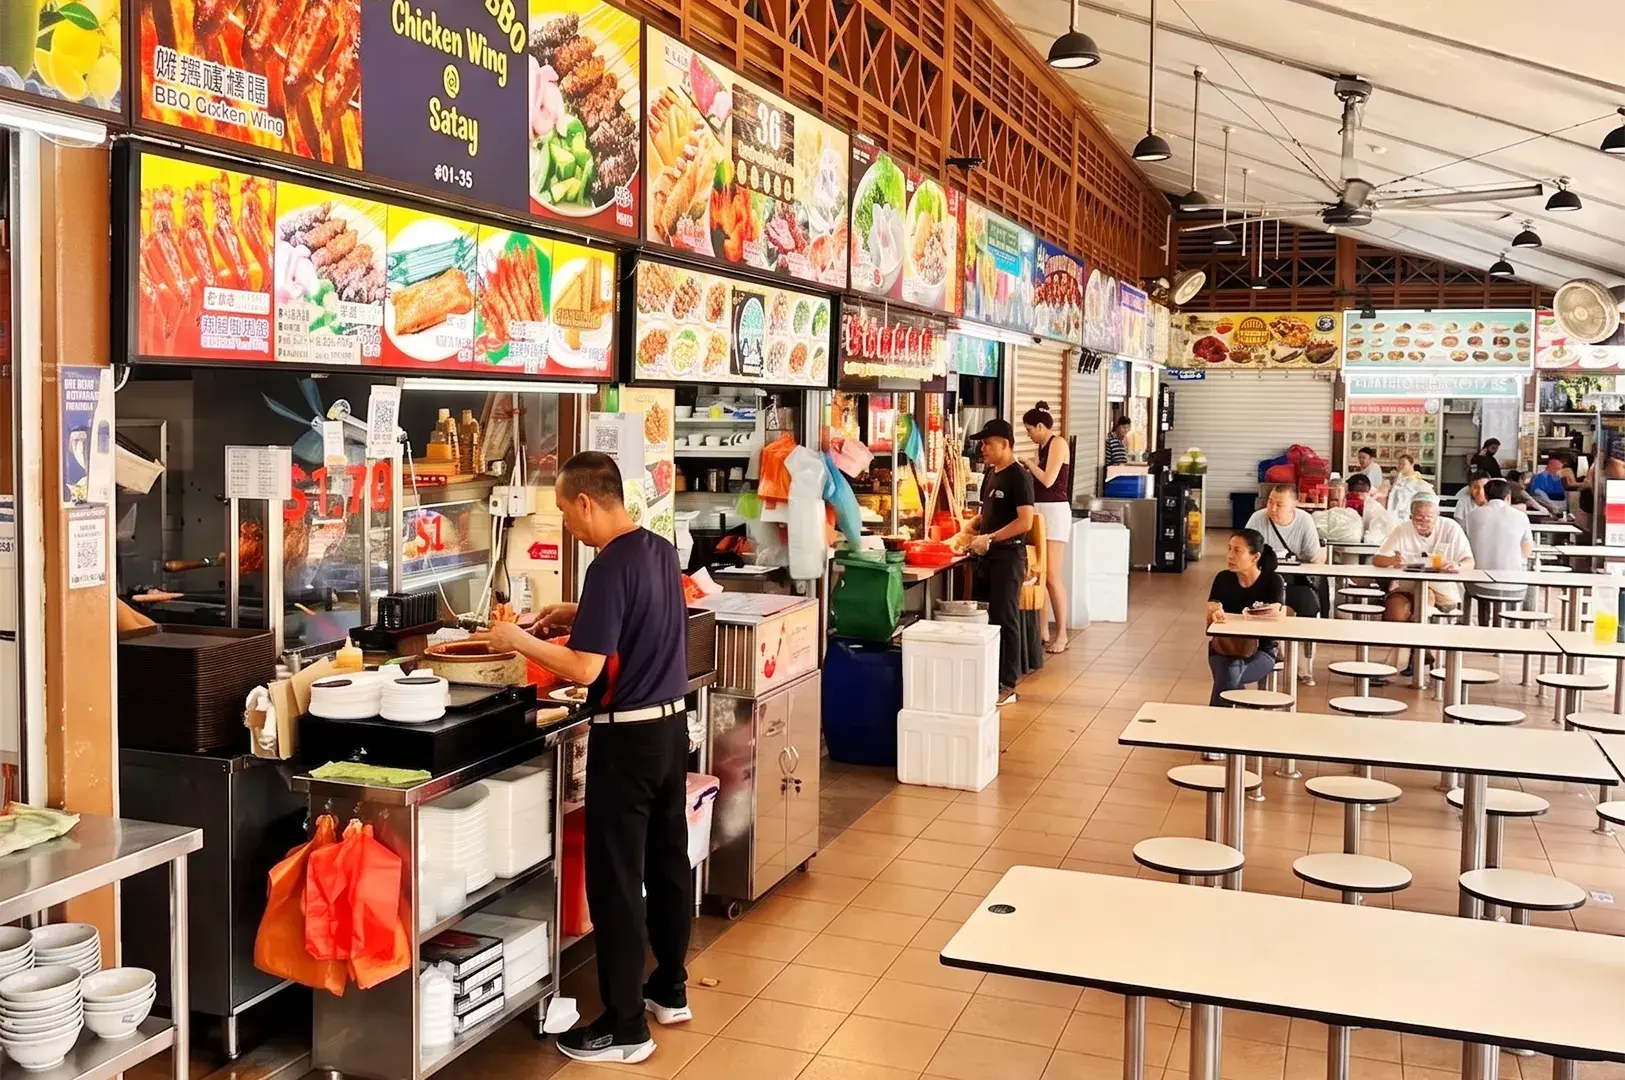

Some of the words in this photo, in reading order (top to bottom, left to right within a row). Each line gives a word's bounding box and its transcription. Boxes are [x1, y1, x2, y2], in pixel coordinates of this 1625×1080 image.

[391, 0, 464, 59] Chicken
[465, 27, 508, 88] Wing
[443, 64, 460, 99] @
[154, 85, 191, 111] BBQ
[250, 110, 283, 137] Wing
[428, 96, 478, 157] Satay
[756, 103, 782, 151] 36
[434, 164, 474, 189] #01-35
